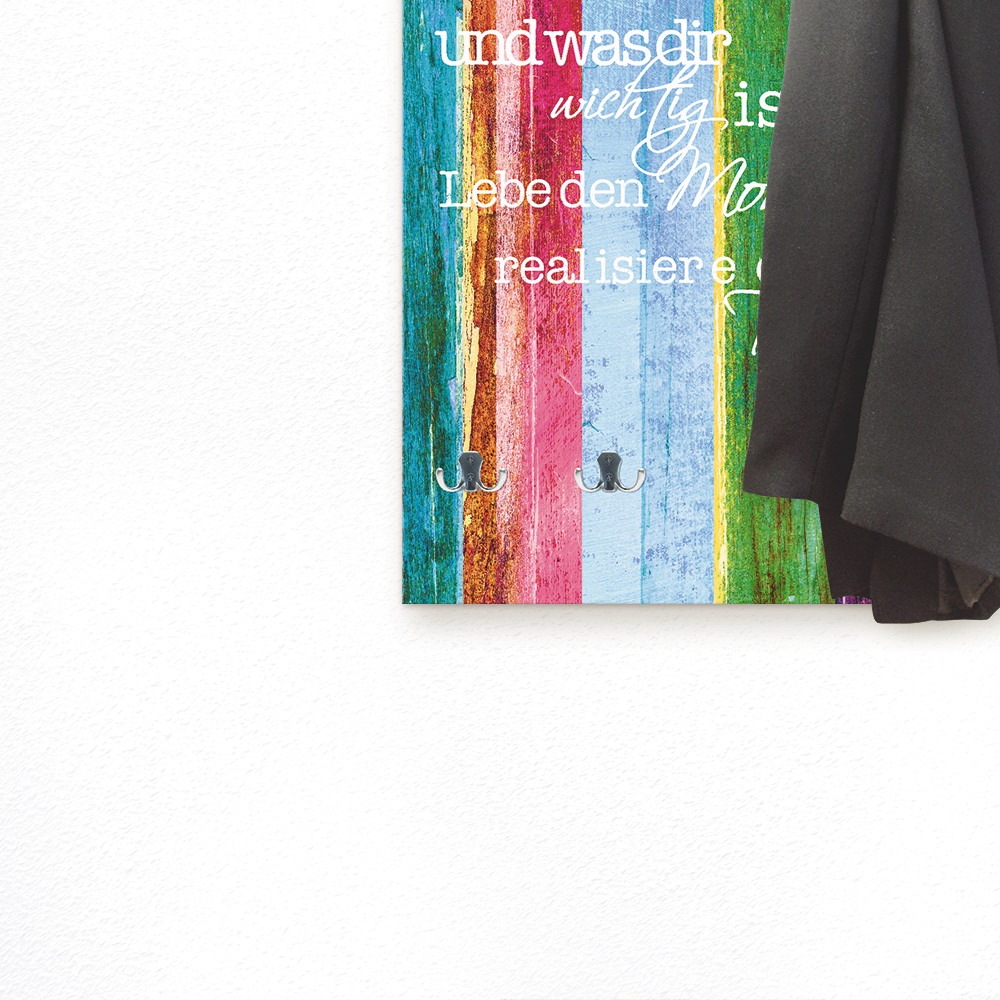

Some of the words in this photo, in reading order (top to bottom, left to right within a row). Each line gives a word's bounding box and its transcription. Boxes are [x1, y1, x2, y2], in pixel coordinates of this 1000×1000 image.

[435, 19, 543, 66] und
[543, 30, 651, 66] was
[655, 19, 732, 66] dir
[550, 48, 729, 177] wichtig
[439, 170, 551, 208] Lebe
[559, 170, 649, 208] den
[656, 146, 767, 218] Mo
[494, 249, 736, 285] realisiere
